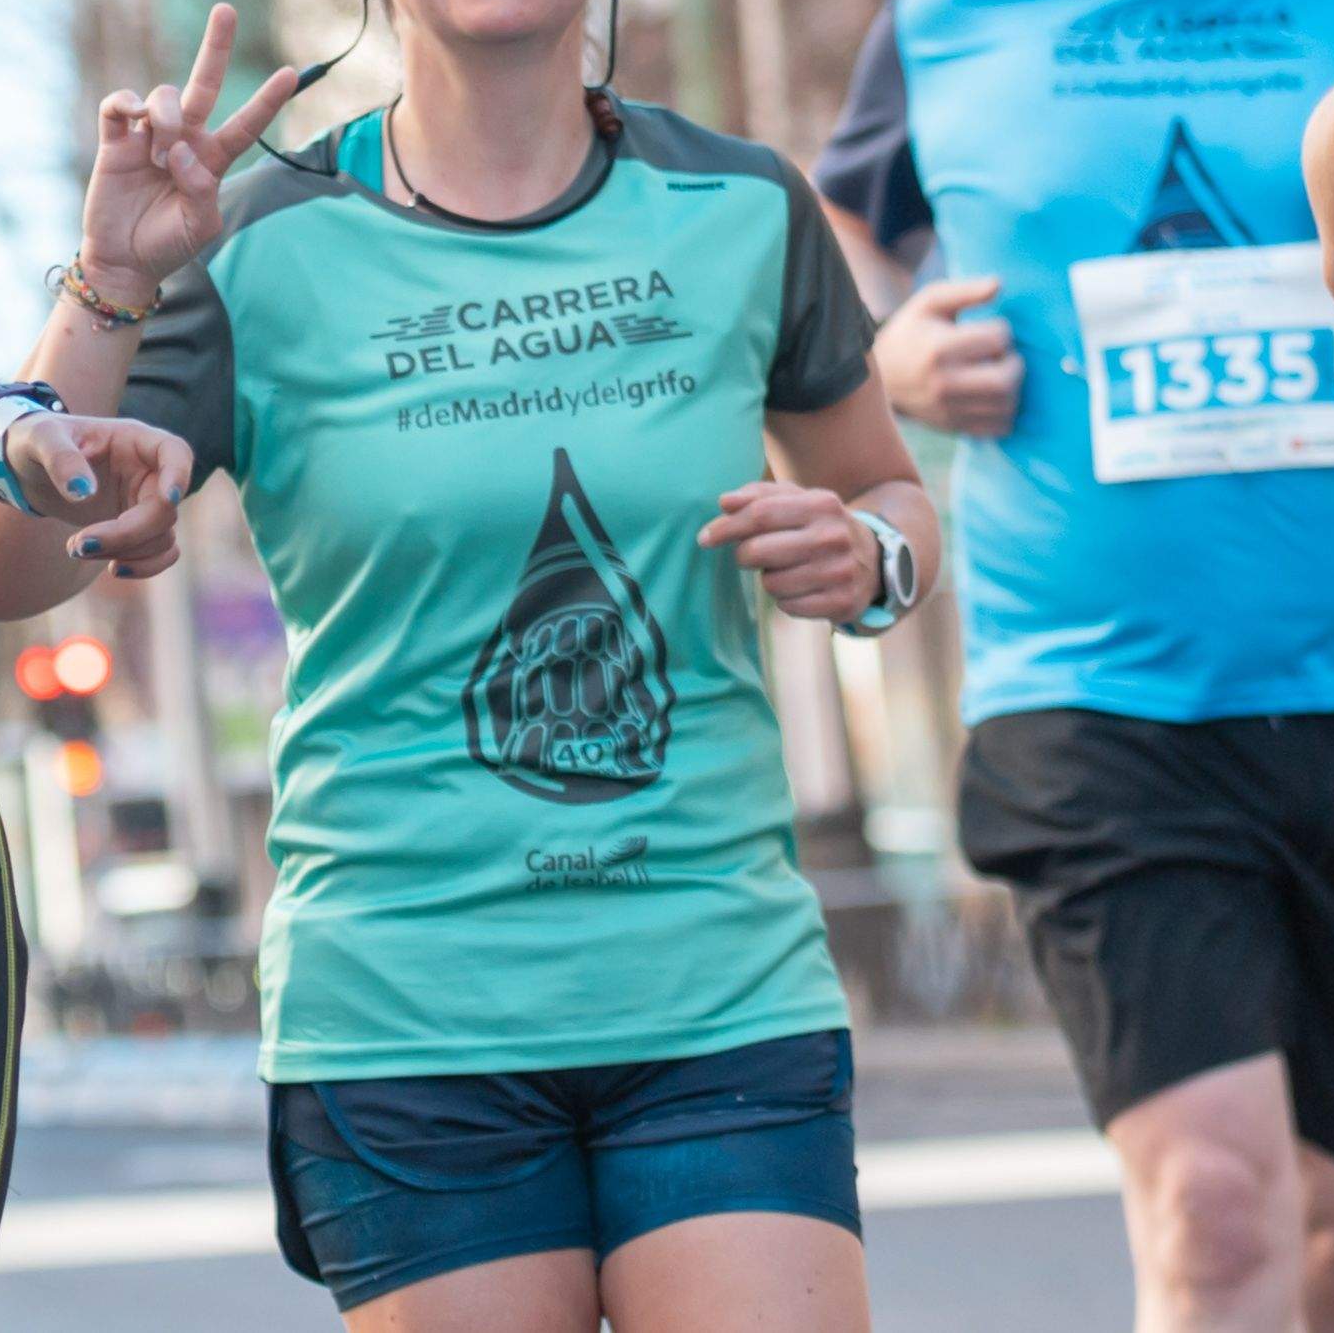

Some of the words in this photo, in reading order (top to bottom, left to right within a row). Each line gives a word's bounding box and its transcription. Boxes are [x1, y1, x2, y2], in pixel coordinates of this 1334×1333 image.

[456, 270, 674, 331] CARRERA
[384, 343, 475, 380] DEL
[490, 321, 617, 366] AGUA
[1118, 330, 1321, 416] 1335
[397, 369, 697, 433] #deMadridydelgrifo
[525, 845, 596, 873] Canal
